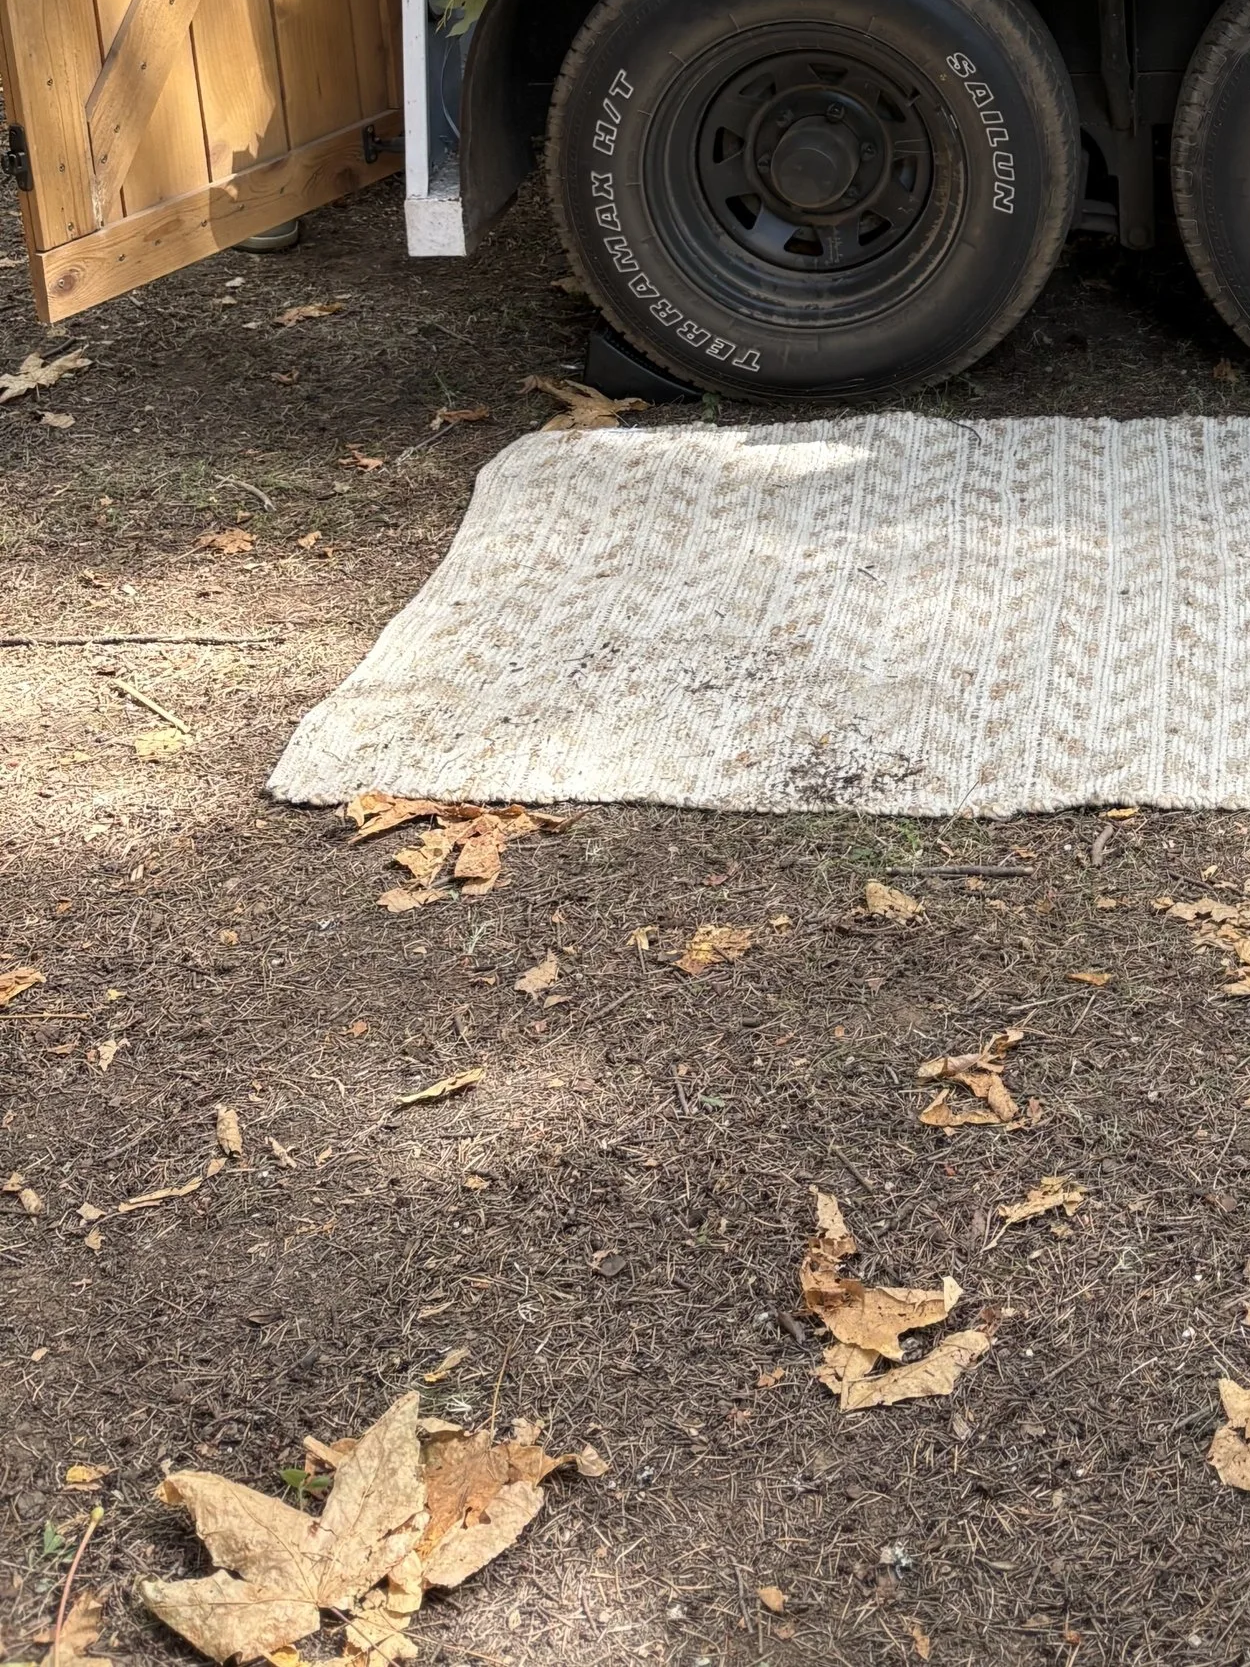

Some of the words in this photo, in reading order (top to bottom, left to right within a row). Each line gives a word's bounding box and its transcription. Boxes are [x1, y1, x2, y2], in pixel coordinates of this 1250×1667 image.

[592, 69, 635, 155] H/T
[945, 52, 1016, 213] SAILUN
[590, 171, 762, 372] TERRAMAX
